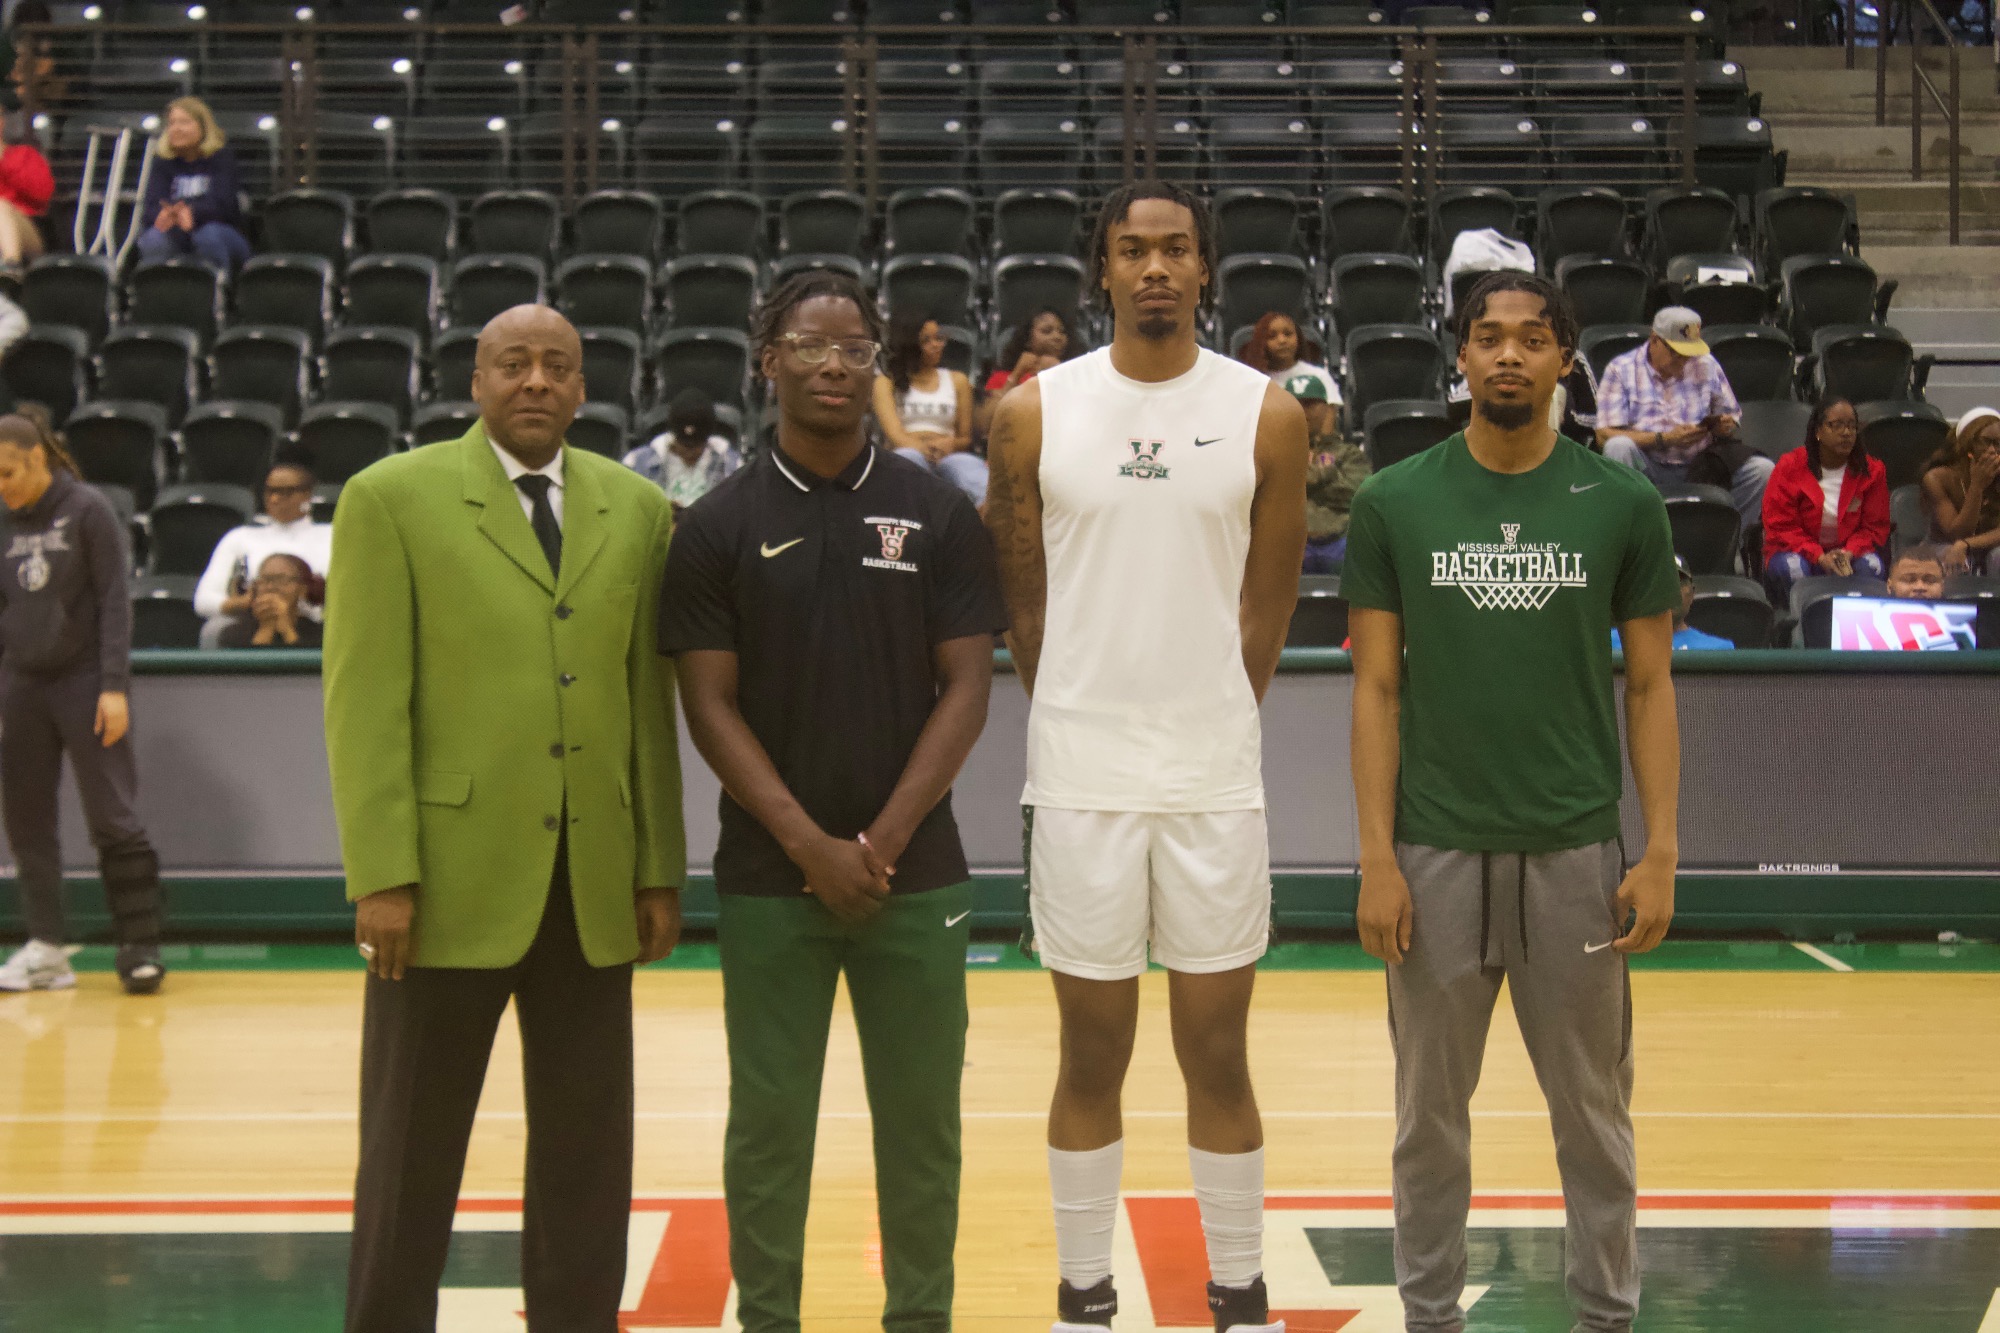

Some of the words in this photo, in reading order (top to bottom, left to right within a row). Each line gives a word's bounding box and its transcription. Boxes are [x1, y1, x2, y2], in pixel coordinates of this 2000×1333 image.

[1457, 542, 1518, 553] MISSISSIPPI
[1520, 542, 1561, 552] VALLEY
[862, 557, 918, 572] BASKETBALL
[1431, 552, 1587, 582] BASKETBALL
[1759, 863, 1840, 872] DAKTRONICS
